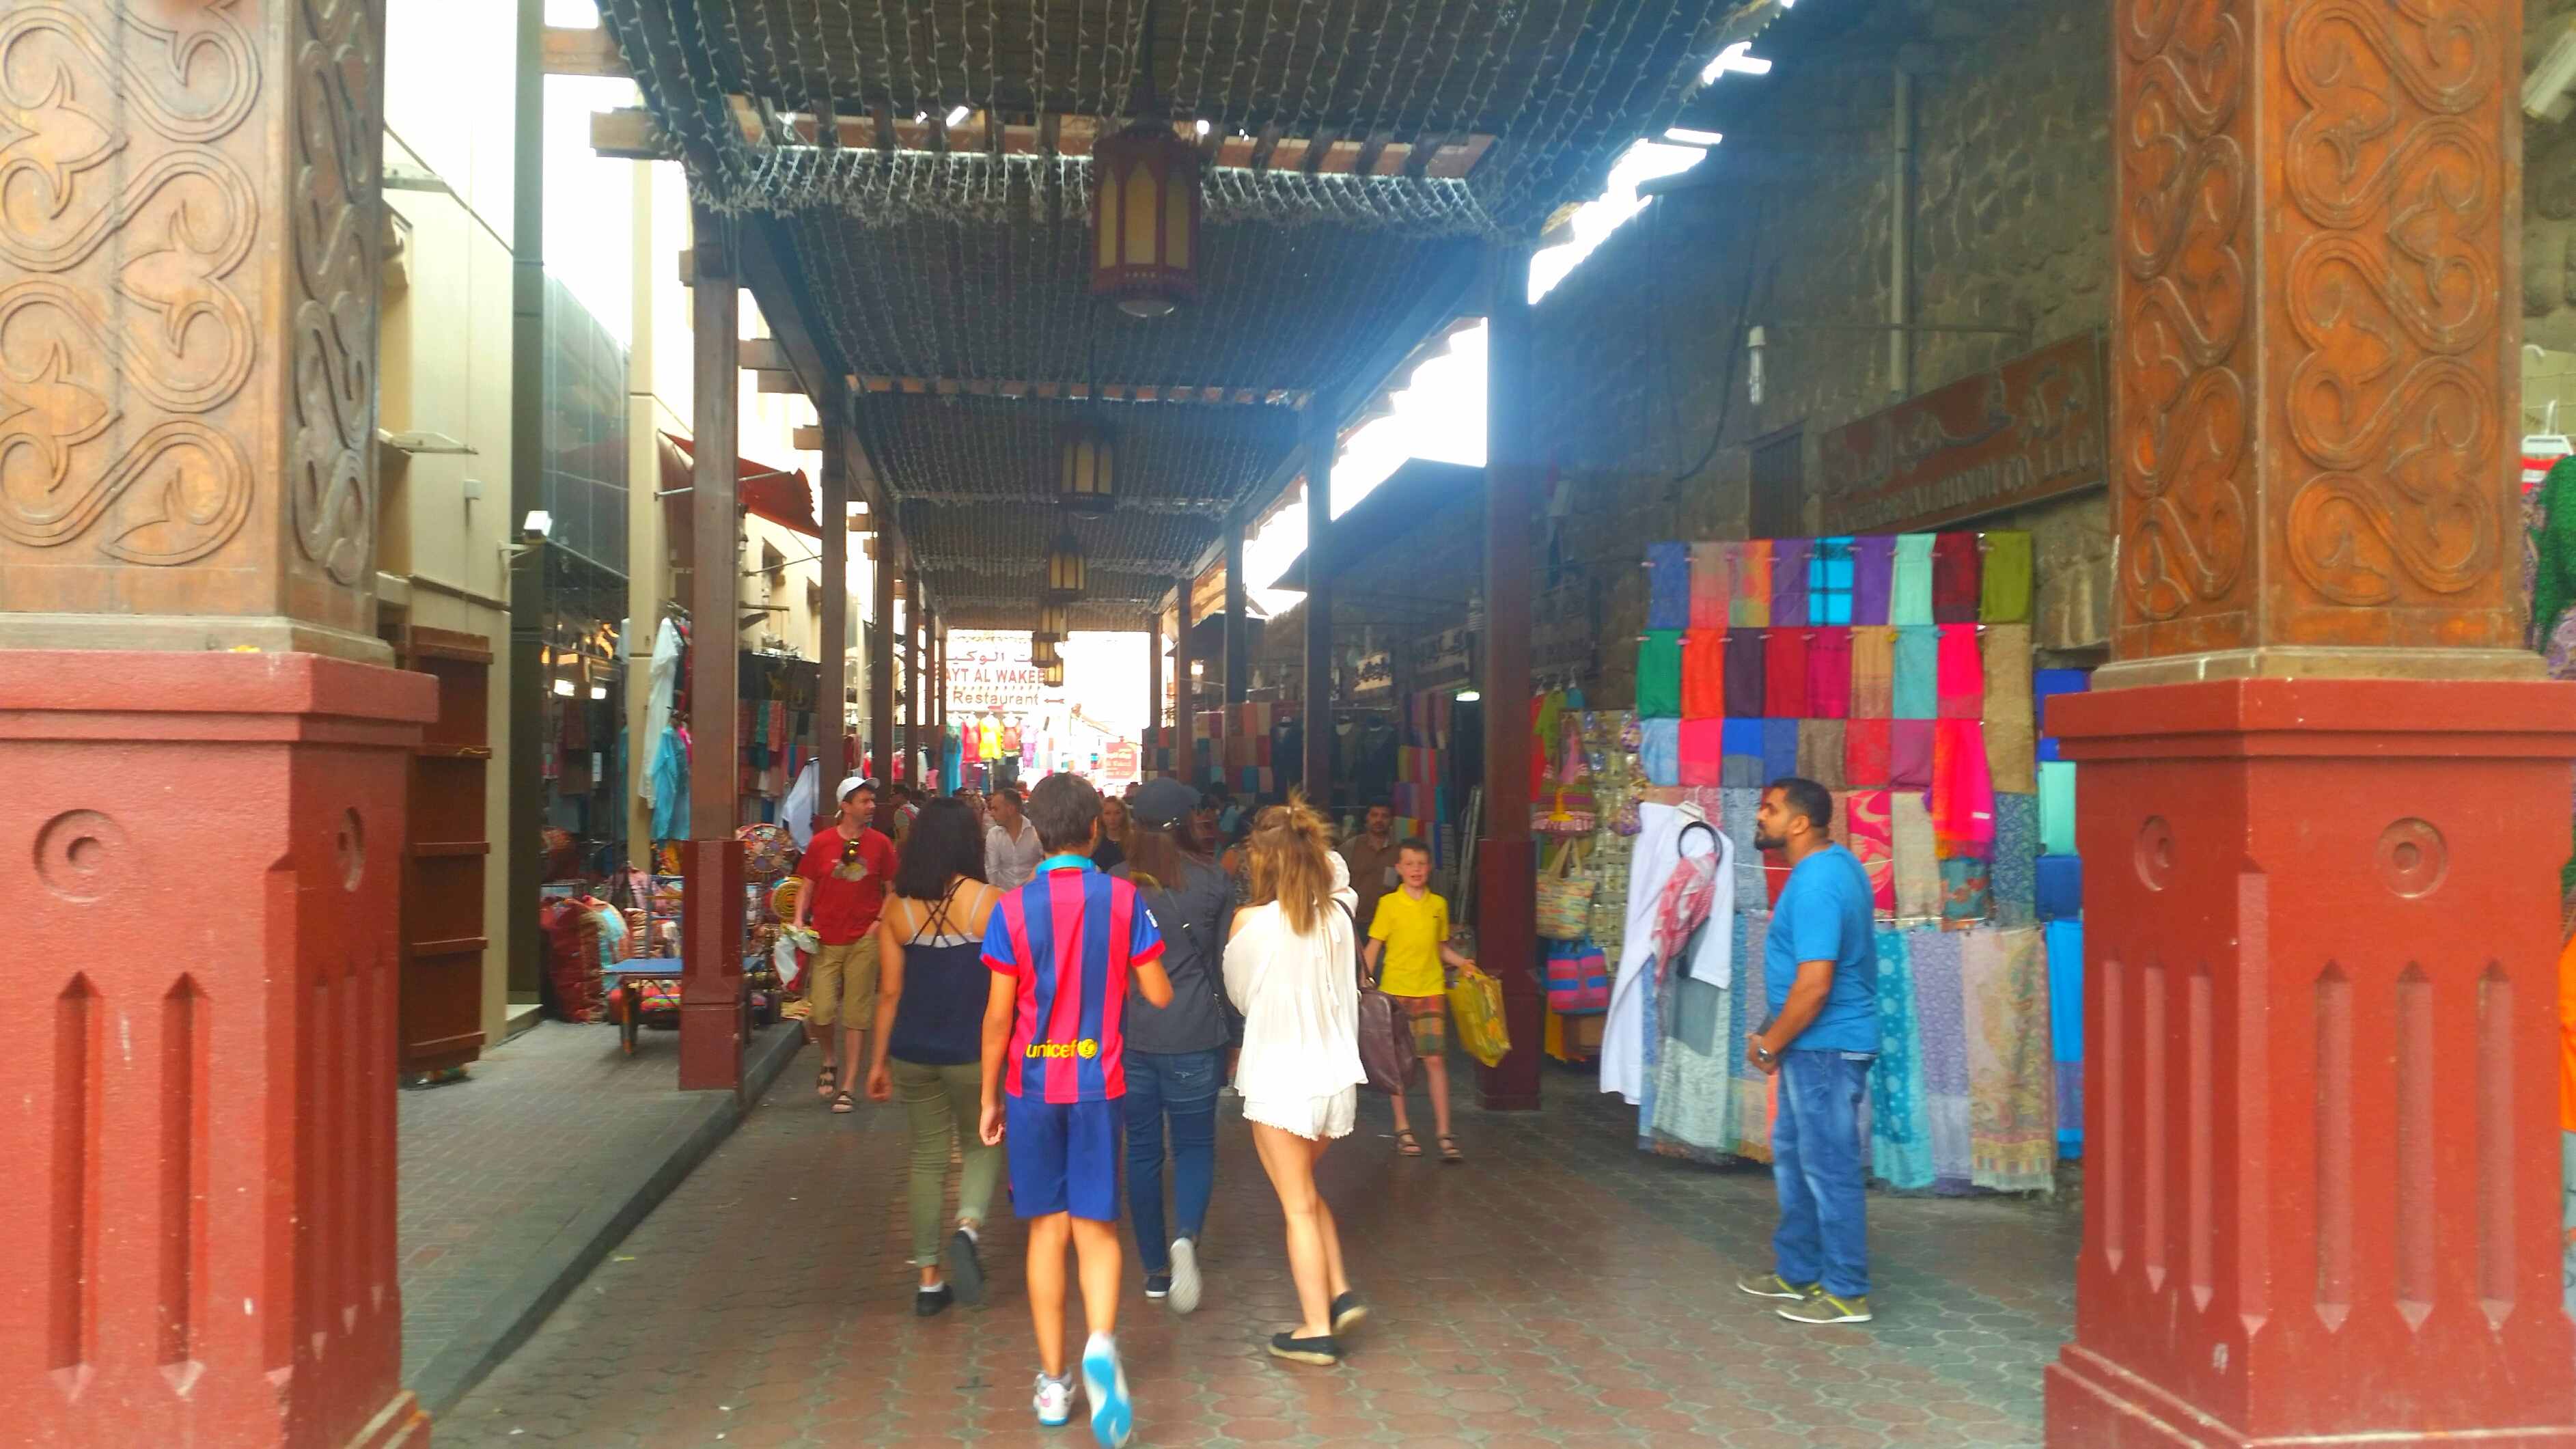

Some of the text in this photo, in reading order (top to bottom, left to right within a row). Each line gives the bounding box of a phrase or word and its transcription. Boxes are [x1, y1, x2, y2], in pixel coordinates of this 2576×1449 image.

[946, 650, 1005, 665] الوكي
[974, 668, 991, 683] AL
[995, 668, 1045, 684] WAKEE
[952, 690, 1039, 706] Restaurant
[1025, 1038, 1078, 1059] unicef
